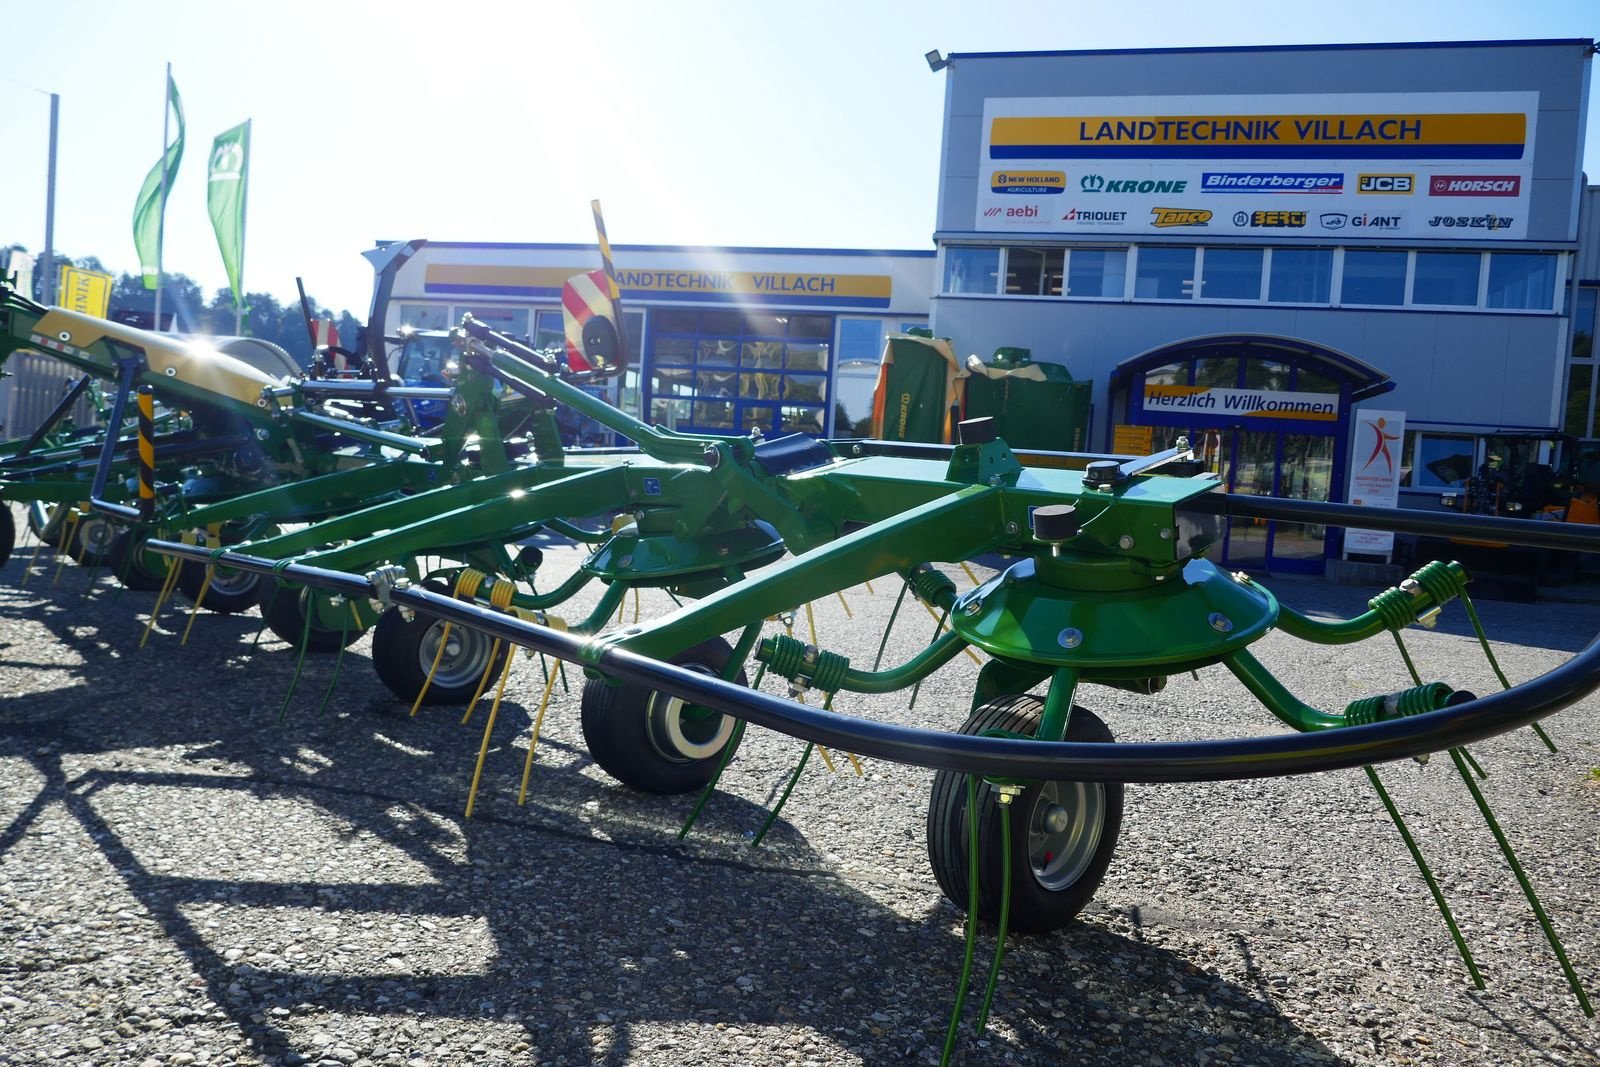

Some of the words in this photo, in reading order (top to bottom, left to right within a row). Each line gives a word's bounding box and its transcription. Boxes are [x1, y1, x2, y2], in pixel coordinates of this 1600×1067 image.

[1079, 120, 1281, 141] LANDTECHNIK
[1294, 119, 1422, 140] VILLACH
[1105, 180, 1188, 194] KRONE
[1206, 175, 1340, 188] Binderberger
[1361, 177, 1410, 191] JCB
[1448, 180, 1515, 192] HORSCH
[1006, 205, 1038, 217] aebi
[1152, 208, 1212, 227] Tanco
[753, 275, 835, 292] VILLACH
[1149, 391, 1216, 409] Herzlich
[1224, 394, 1334, 415] Willkommen
